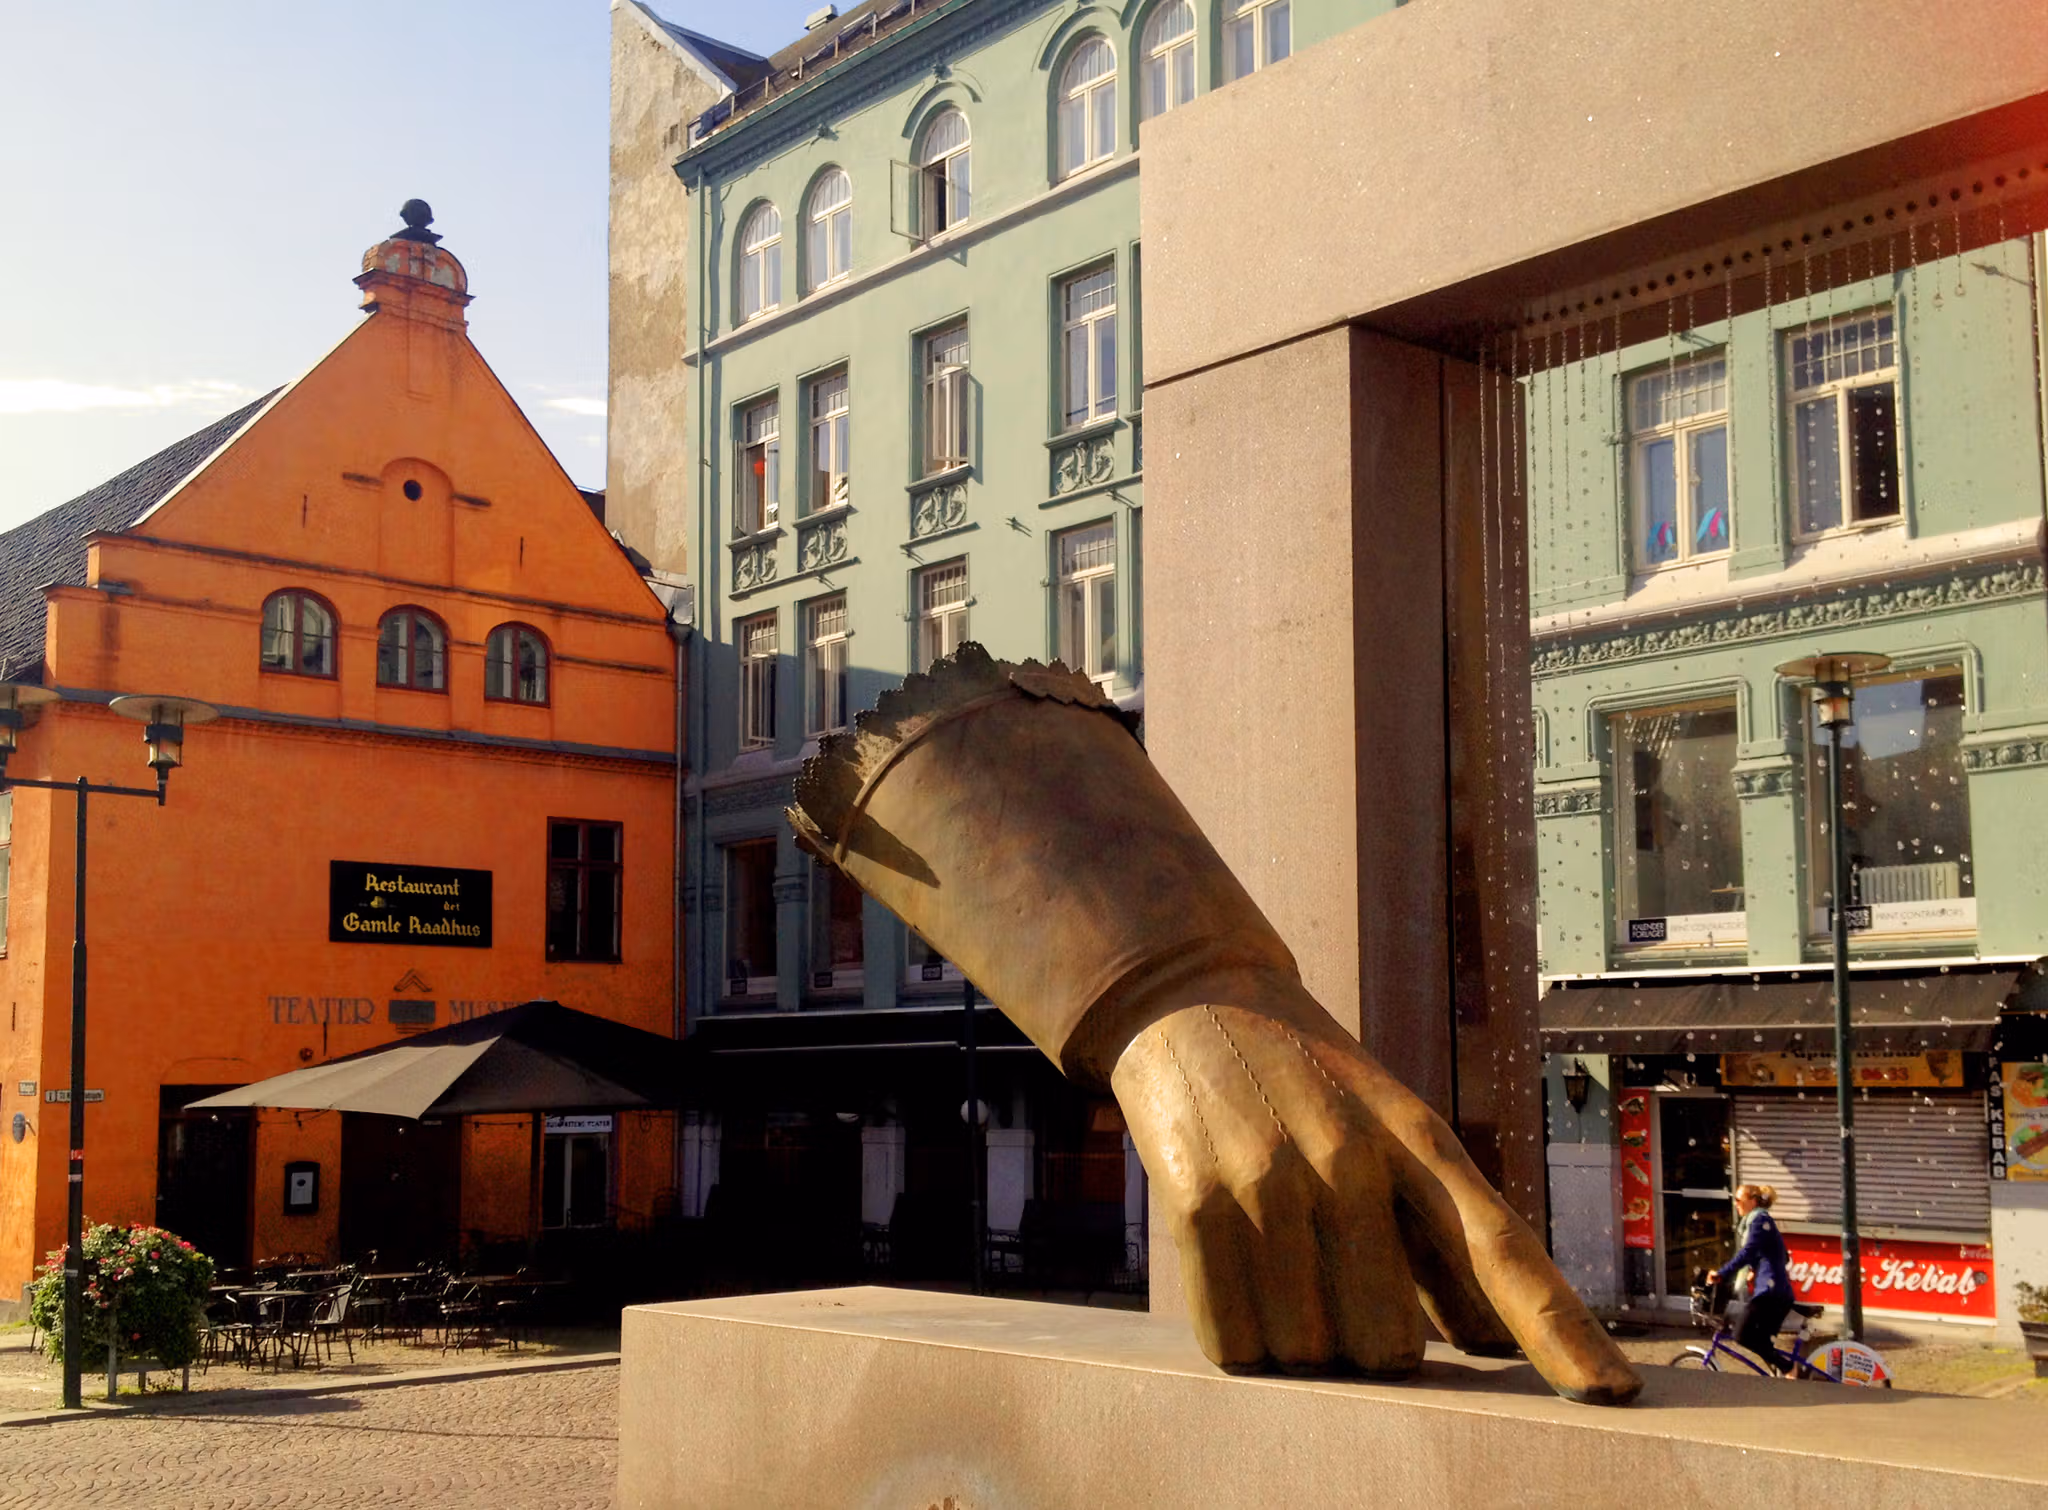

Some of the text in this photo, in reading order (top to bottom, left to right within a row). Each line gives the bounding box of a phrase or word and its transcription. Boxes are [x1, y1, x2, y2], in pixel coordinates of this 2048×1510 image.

[365, 873, 460, 896] Restaurant
[343, 912, 481, 937] Gamle Raadhus
[268, 996, 376, 1025] TEATER
[1990, 1108, 2006, 1178] KEBAB
[1871, 1258, 1977, 1296] Kebab
